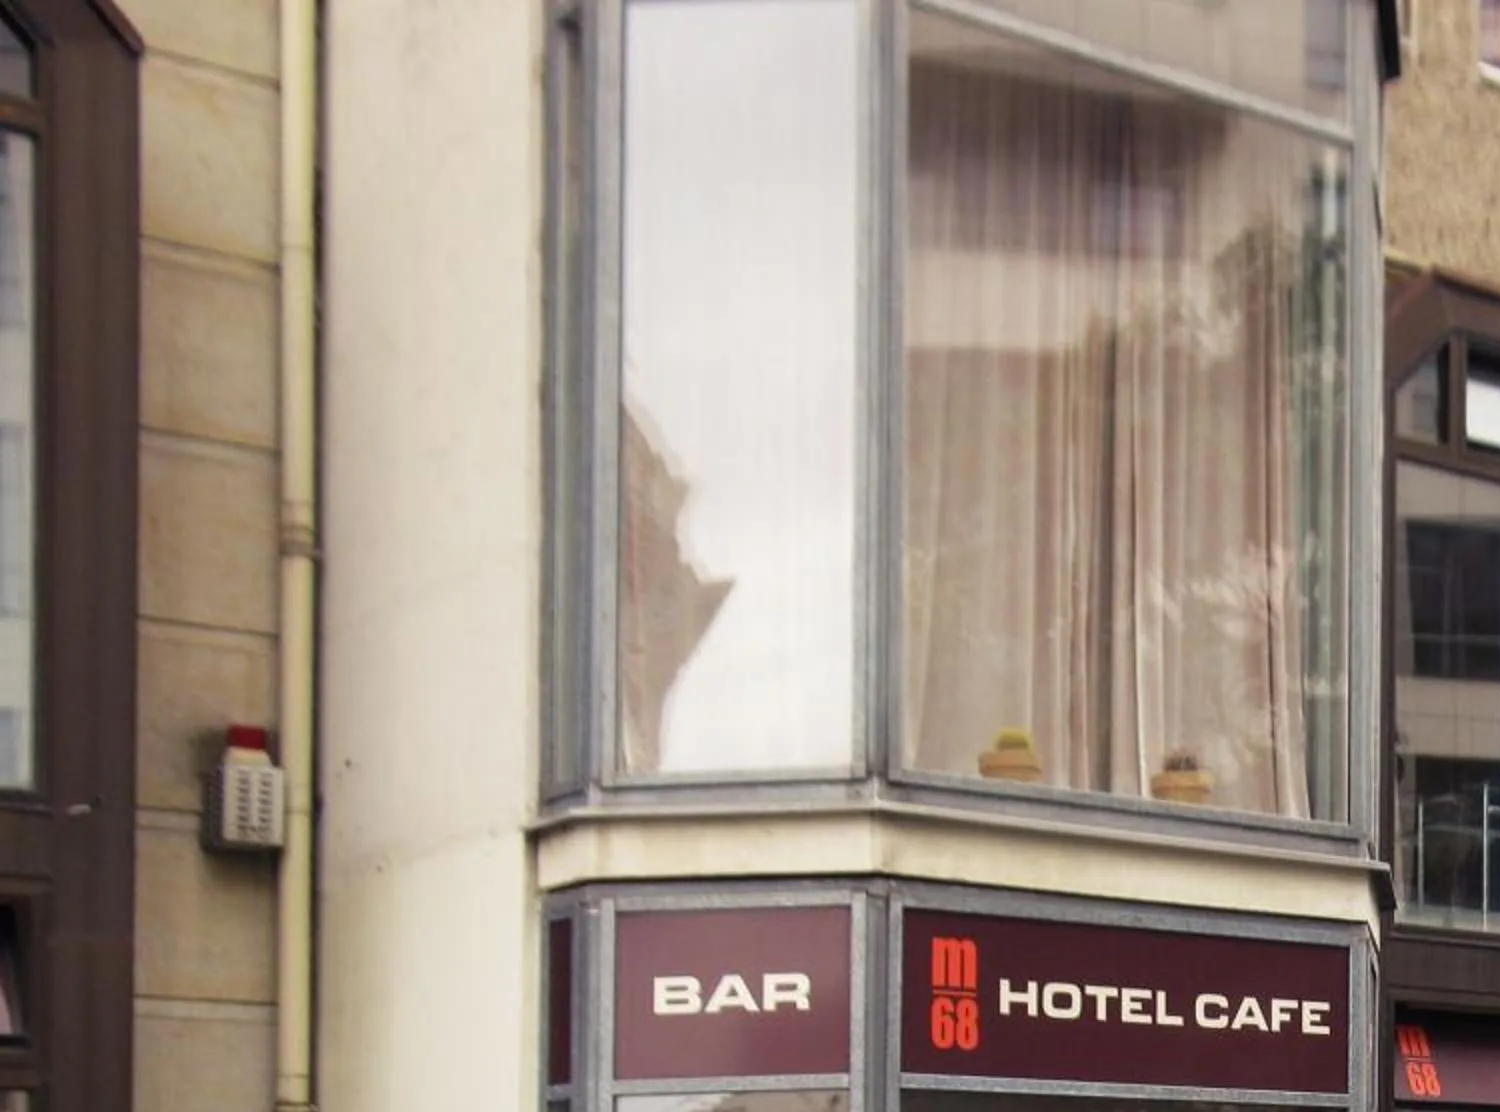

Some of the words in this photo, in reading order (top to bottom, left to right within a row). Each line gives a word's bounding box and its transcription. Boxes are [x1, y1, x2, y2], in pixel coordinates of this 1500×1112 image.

[653, 972, 811, 1015] BAR
[999, 978, 1185, 1027] HOTEL
[1194, 992, 1331, 1036] CAFE
[931, 998, 979, 1051] 68
[1406, 1062, 1441, 1097] 68
